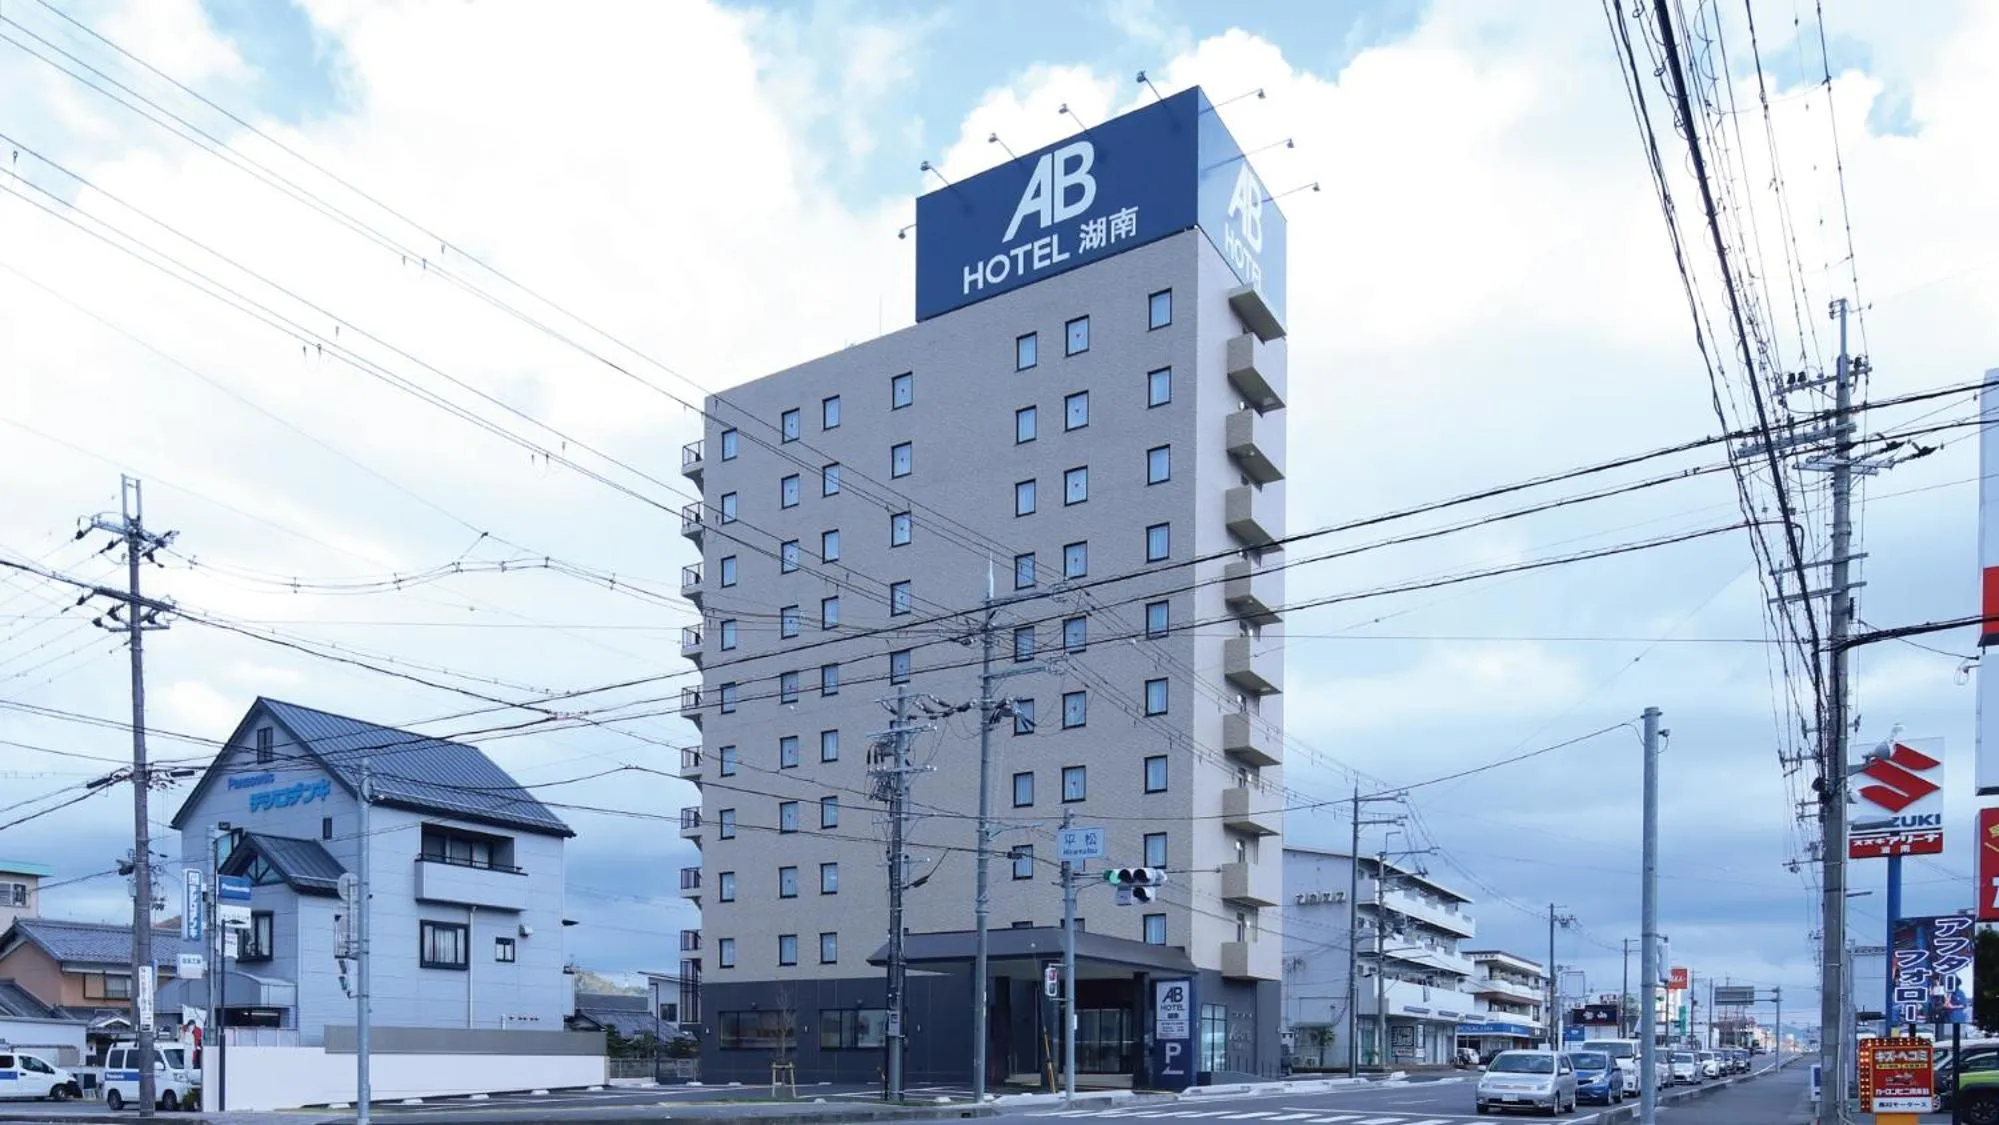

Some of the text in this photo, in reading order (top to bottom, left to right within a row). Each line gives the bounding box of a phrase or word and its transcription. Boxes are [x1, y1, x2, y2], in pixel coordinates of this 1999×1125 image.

[1001, 140, 1097, 244] AB
[1228, 161, 1263, 255] AB
[963, 205, 1139, 295] HOTEL 湖南
[1064, 832, 1098, 846] 平松
[1894, 949, 1933, 1022] フォロー
[1932, 917, 1973, 993] アフター
[1160, 1003, 1186, 1012] HOTEL
[1162, 986, 1184, 1003] AB
[1165, 1042, 1182, 1064] P
